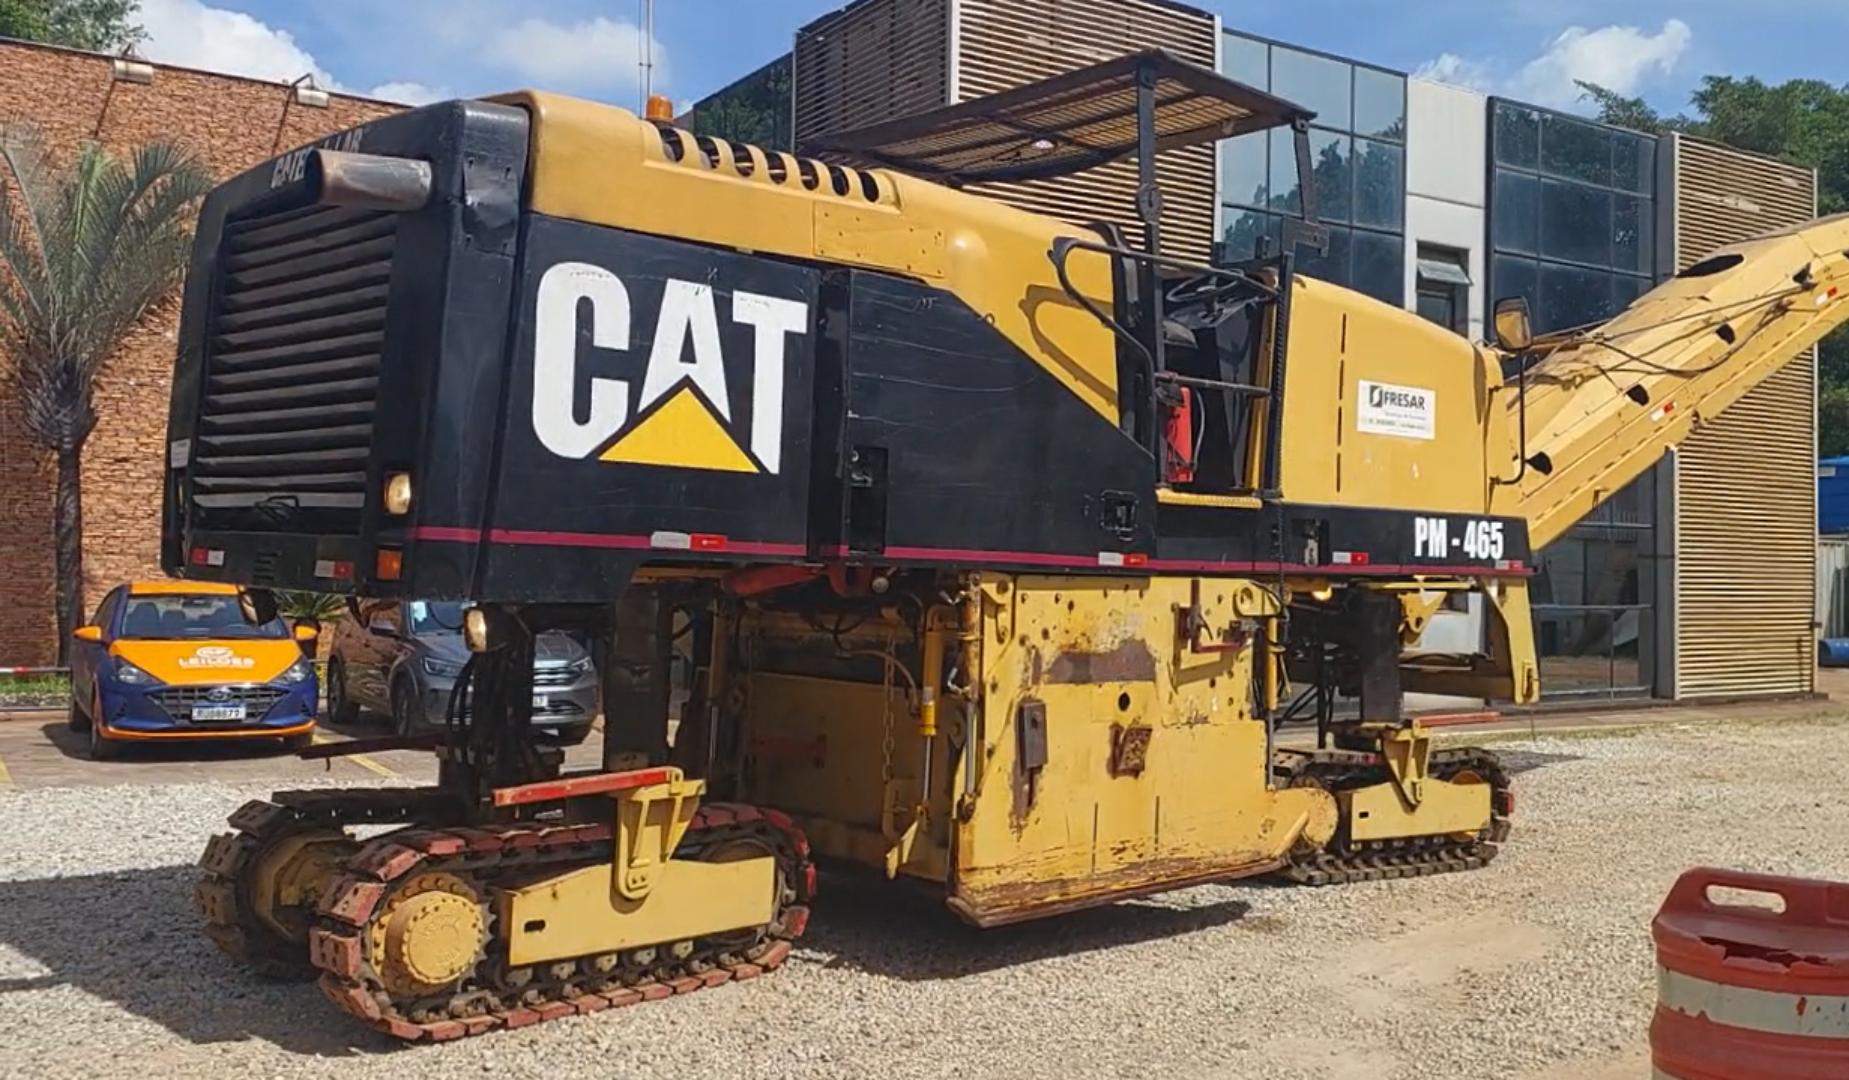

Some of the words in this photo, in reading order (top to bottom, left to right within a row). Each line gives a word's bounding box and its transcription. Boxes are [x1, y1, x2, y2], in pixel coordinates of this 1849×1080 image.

[532, 261, 808, 475] CAT
[1384, 391, 1425, 411] FRESAR
[1414, 517, 1448, 558] PM
[1451, 537, 1461, 546] -
[1463, 520, 1505, 560] 465
